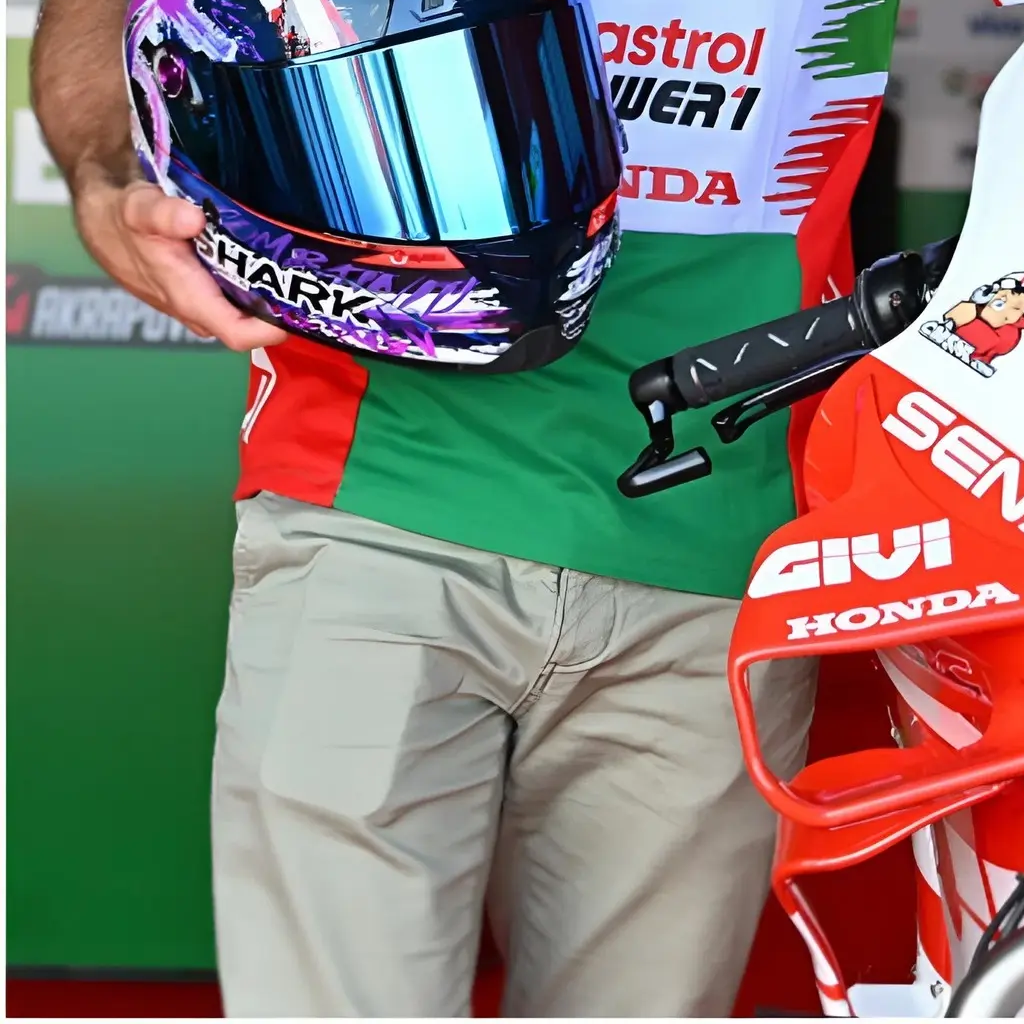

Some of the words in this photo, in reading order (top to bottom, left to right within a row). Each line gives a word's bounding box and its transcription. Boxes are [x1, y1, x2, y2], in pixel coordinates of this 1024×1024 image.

[597, 18, 766, 75] astrol
[610, 74, 761, 131] WER1
[618, 164, 741, 206] NDA
[195, 233, 376, 329] SHARK
[747, 517, 953, 599] GIVI
[786, 581, 1020, 641] HONDA
